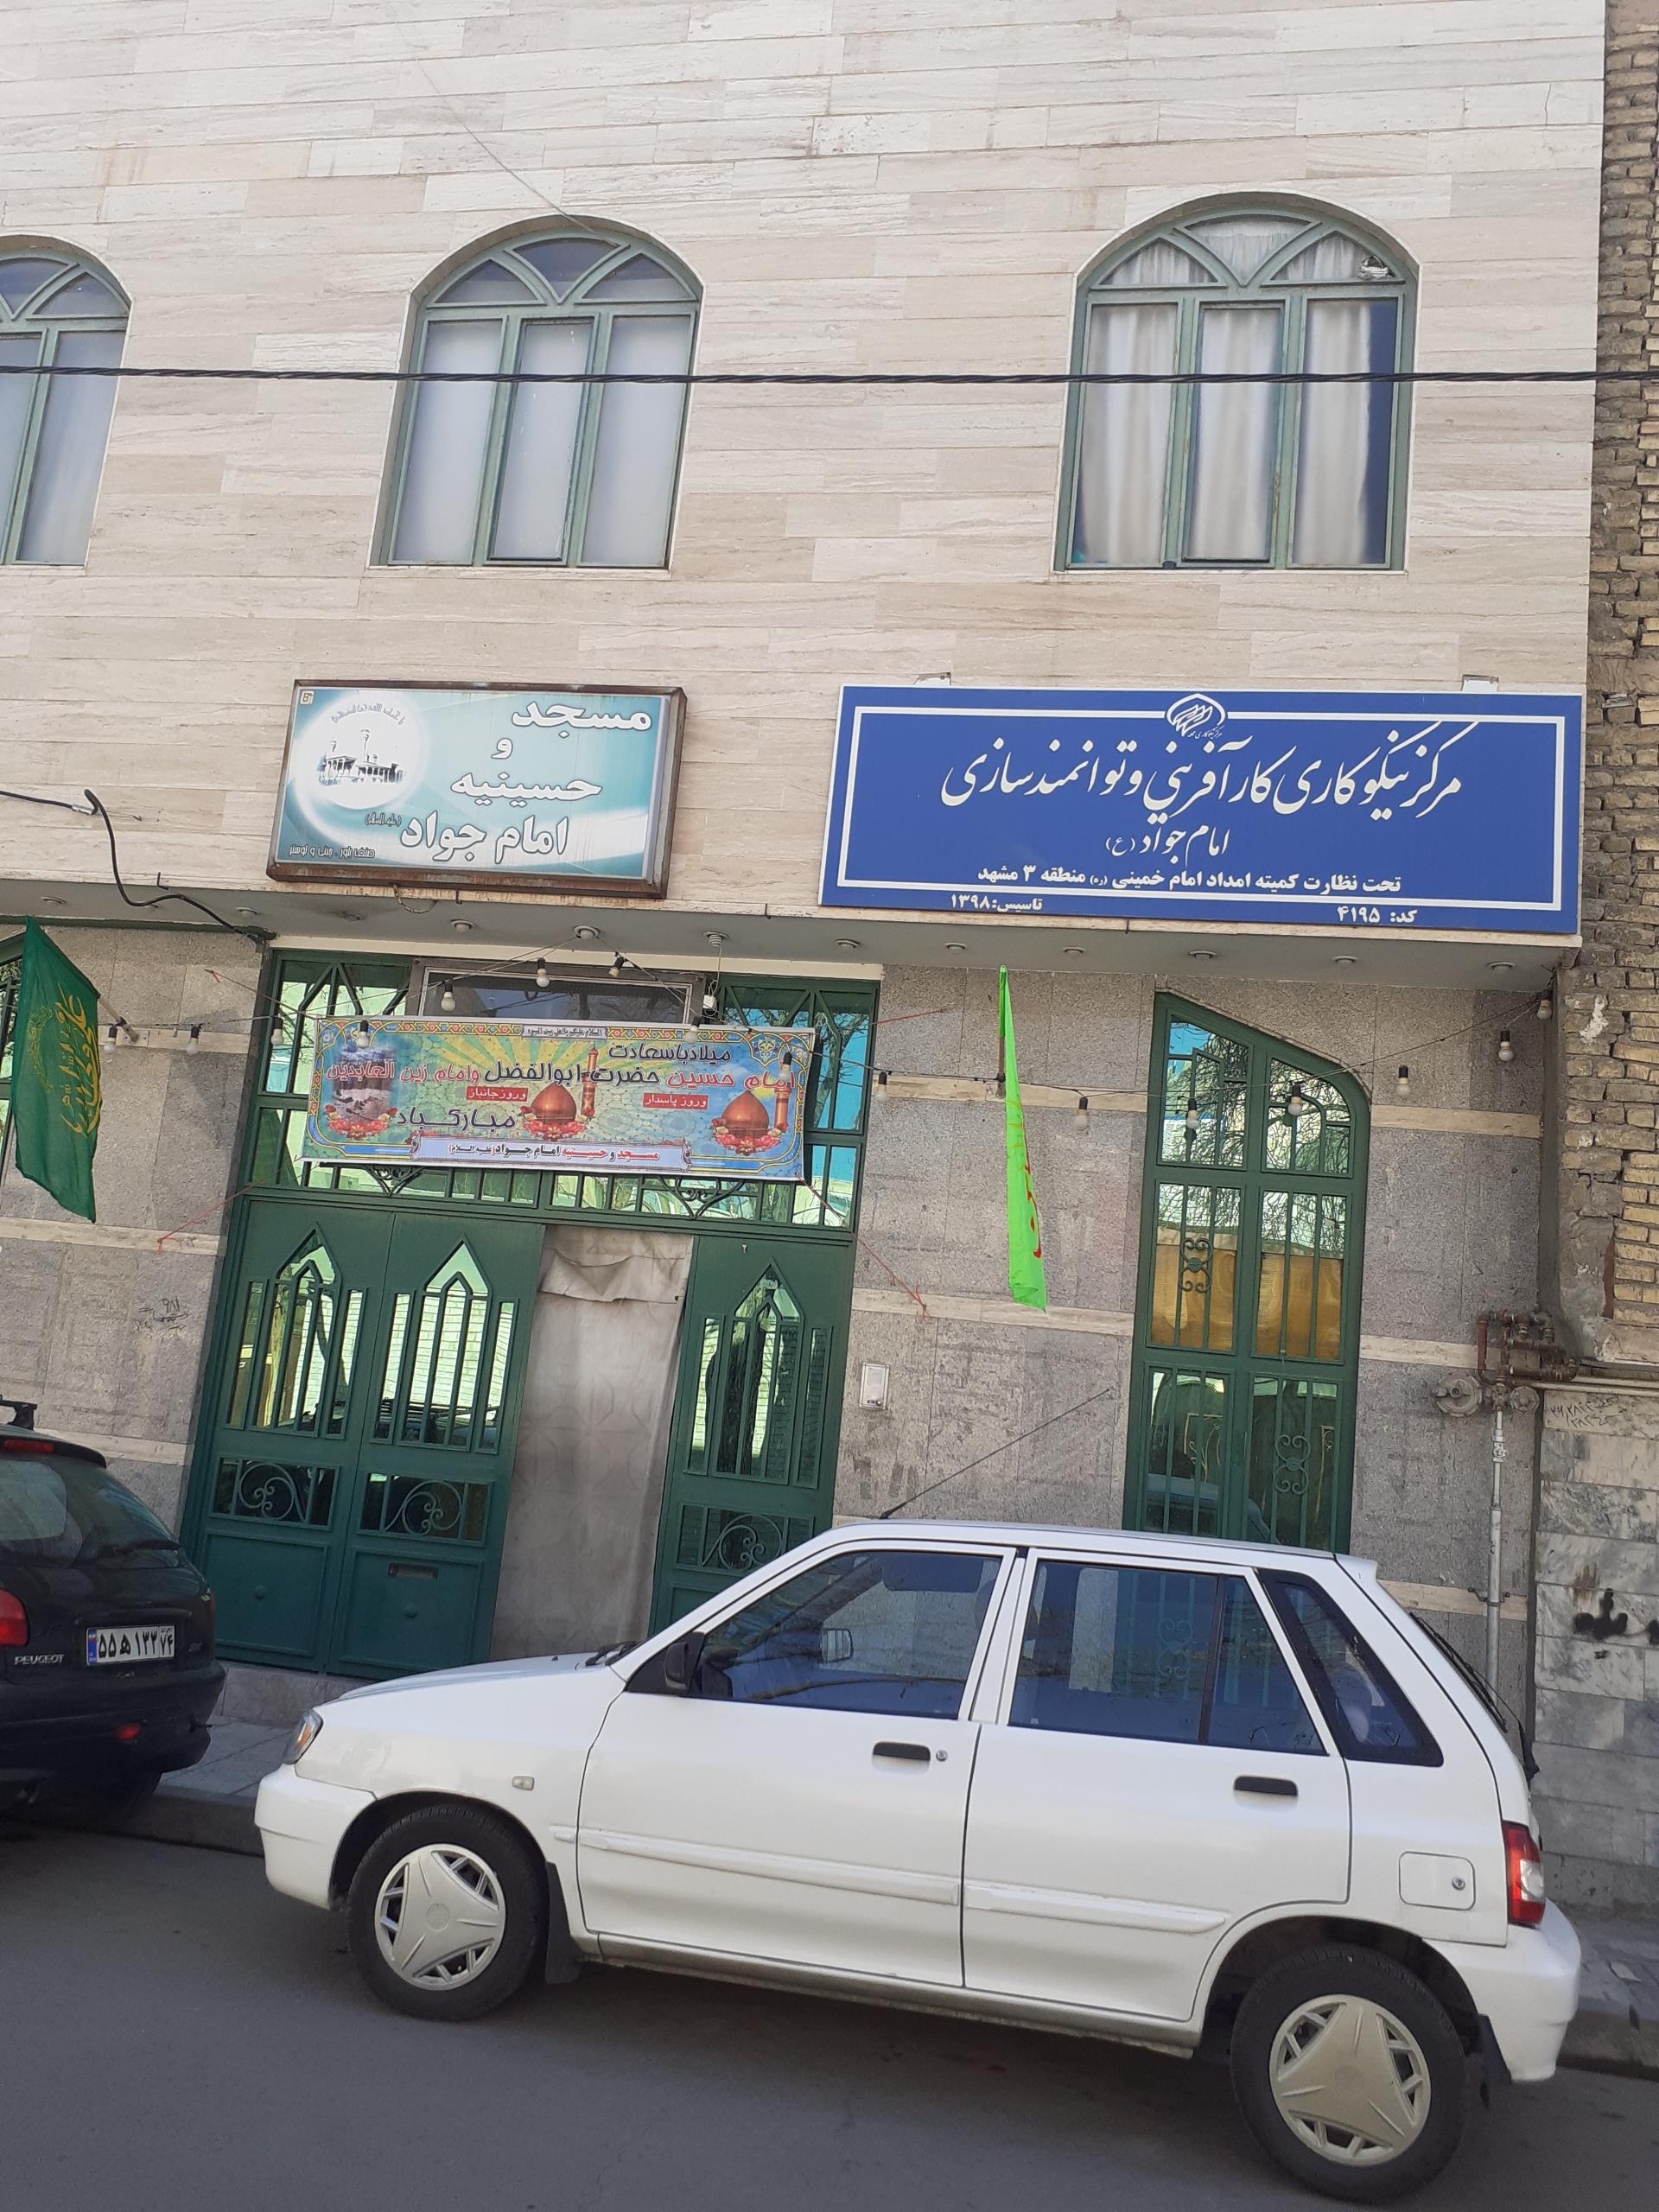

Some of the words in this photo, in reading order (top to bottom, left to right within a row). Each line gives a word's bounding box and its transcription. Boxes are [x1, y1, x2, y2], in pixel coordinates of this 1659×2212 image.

[512, 702, 652, 739] مسجد
[490, 738, 513, 760] و
[1273, 721, 1442, 821] نیکوکاری
[1399, 721, 1479, 818] مرکز
[450, 772, 603, 808] حسینیه
[400, 810, 487, 862] جواد
[494, 814, 569, 864] امام
[1139, 826, 1187, 864] جواد
[1106, 836, 1136, 856] (ع)
[1185, 825, 1230, 868] امام
[977, 864, 1019, 883] مشهد
[1023, 864, 1036, 882] ۳
[1040, 867, 1086, 883] منطقه
[1112, 870, 1165, 889] خمینی
[1169, 870, 1203, 891] امام
[1206, 871, 1250, 888] امداد
[1255, 873, 1300, 893] کمیته
[1303, 874, 1357, 894] نظارت
[1362, 876, 1402, 893] تحت
[1337, 906, 1381, 922] ۴۱۹۵
[1389, 909, 1418, 923] کد:
[326, 1060, 396, 1083] العابدین
[399, 1063, 429, 1084] زین
[590, 1065, 660, 1088] حضرت
[666, 1071, 734, 1090] حسین
[744, 1071, 796, 1090] امام
[467, 1088, 499, 1099] جانباز
[644, 1094, 677, 1107] پاسدار
[533, 1146, 560, 1159] امام
[562, 1147, 608, 1159] حسینیه
[609, 1151, 615, 1160] و
[617, 1147, 660, 1161] مسجد
[14, 1654, 65, 1666] PEUGEOT
